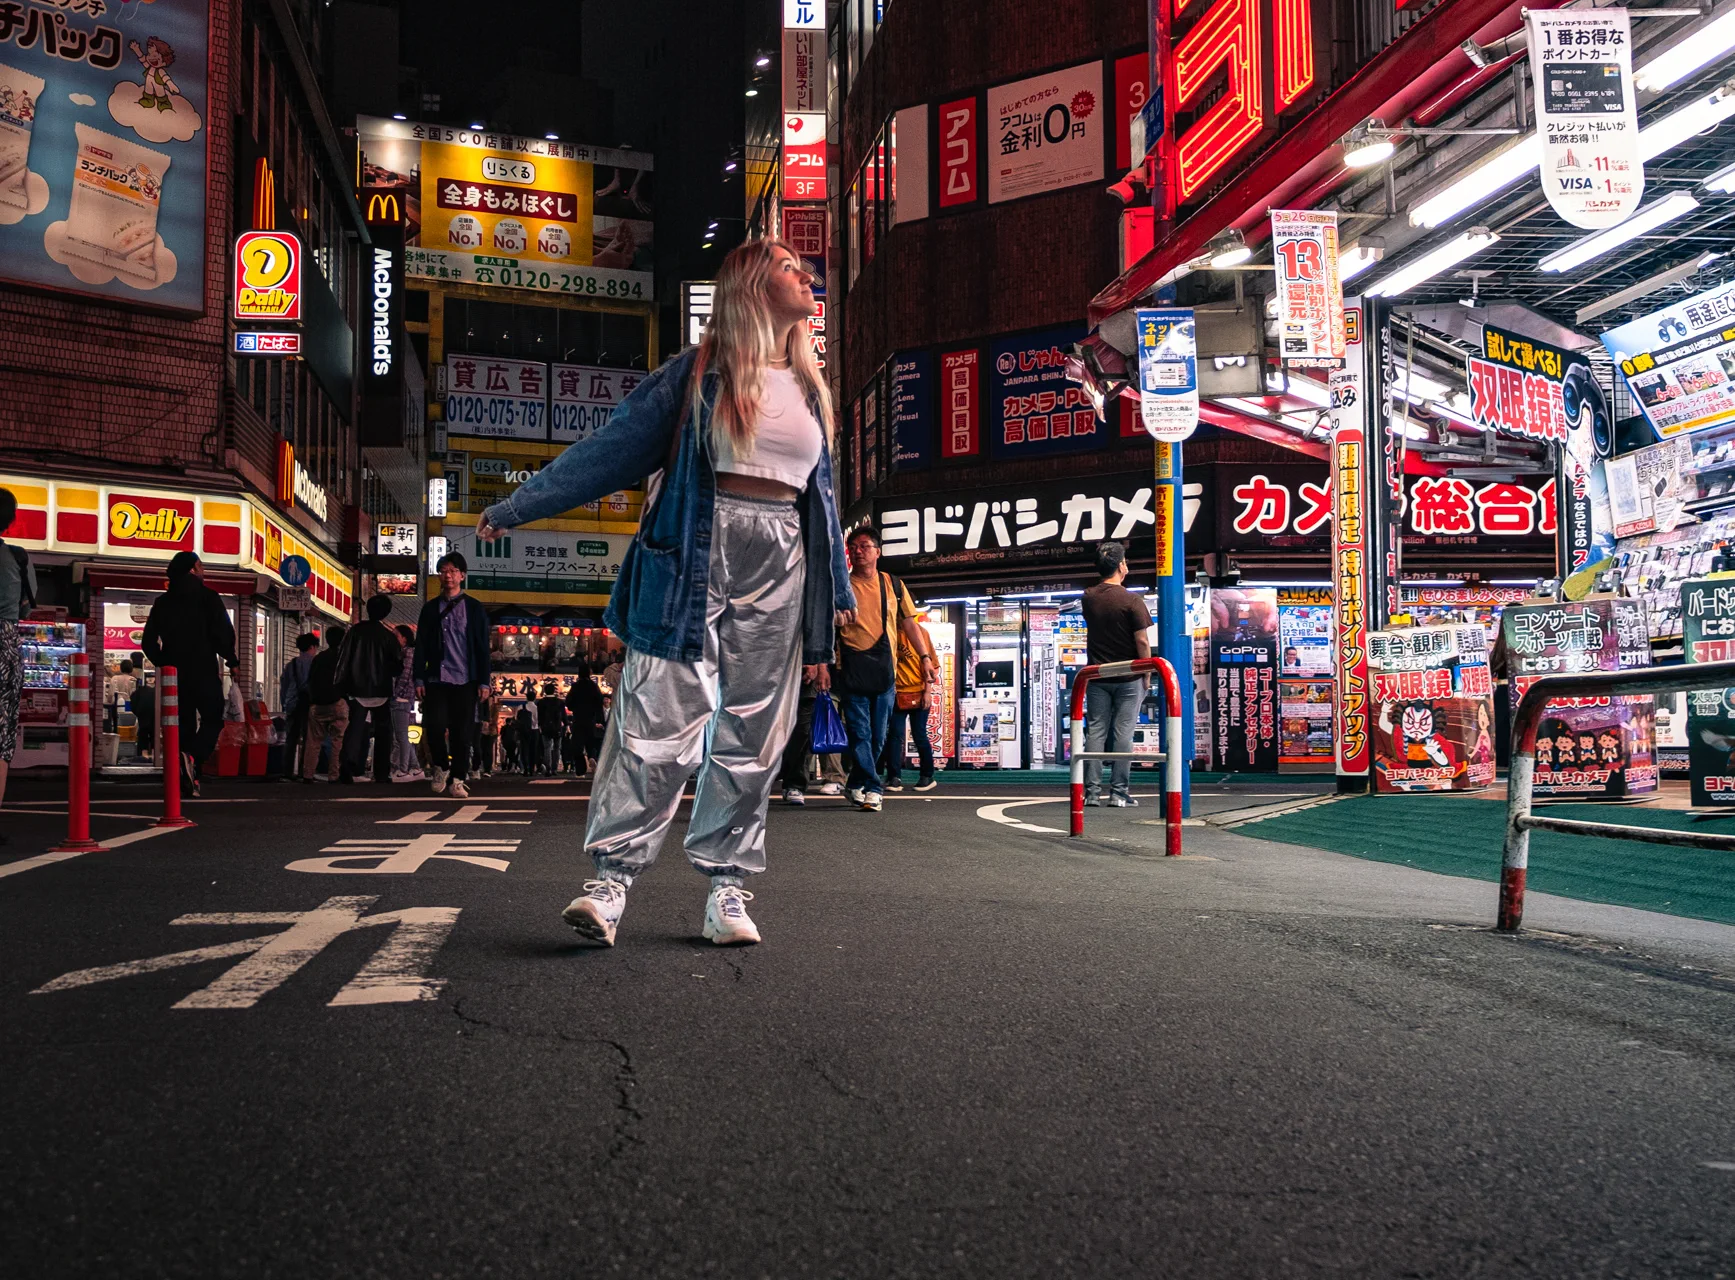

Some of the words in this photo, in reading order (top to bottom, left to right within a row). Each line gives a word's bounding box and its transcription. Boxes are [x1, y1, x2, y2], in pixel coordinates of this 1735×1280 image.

[1543, 28, 1625, 46] 1番お得な
[795, 31, 809, 111] いい部屋ネット
[1000, 85, 1060, 116] はじめての方なら
[1000, 112, 1042, 131] アコムは
[1000, 103, 1086, 156] 金利0円
[1546, 121, 1626, 133] クレジット払いが
[786, 153, 825, 167] アコム
[945, 107, 972, 197] アコム
[80, 159, 128, 184] ランチパック
[487, 163, 531, 180] りらくる
[1594, 157, 1609, 171] 11
[81, 173, 108, 188] たまご
[795, 181, 815, 195] 3F
[1559, 178, 1593, 190] VISA
[1604, 179, 1612, 194] 1
[443, 183, 572, 219] 全身もみほぐし
[458, 223, 473, 231] 全国
[504, 228, 518, 236] 全国
[791, 223, 820, 238] 高価
[448, 230, 483, 247] No.1
[493, 234, 527, 251] No.1
[547, 232, 561, 241] 全国
[537, 239, 571, 256] No.1
[499, 267, 644, 300] 0120-298-894
[239, 287, 298, 316] Daily
[239, 305, 281, 314] YAMAZAKI
[373, 247, 393, 376] McDonald's
[239, 336, 255, 350] 酒
[258, 336, 298, 350] たばこ
[945, 352, 977, 368] カメラ!
[1486, 331, 1562, 380] 試して選べる!
[452, 360, 544, 396] 貸広告
[1003, 374, 1029, 387] JANPARA
[897, 393, 915, 402] Lens
[1469, 360, 1554, 442] 双眼鏡
[953, 367, 970, 454] 高価買取
[1551, 384, 1567, 441] 売場
[1004, 409, 1096, 445] 高価買取
[293, 459, 328, 523] McDonald's
[1337, 442, 1361, 545] 期間限定
[1232, 474, 1557, 535] カメ総合
[109, 501, 194, 542] Daily
[881, 482, 1203, 557] ヨドバシカメラ
[1573, 502, 1589, 548] ならではの
[135, 531, 171, 540] YAMAZAKI
[380, 526, 396, 537] 4F
[524, 545, 569, 559] 完全個室
[936, 551, 974, 564] Yodobashi
[975, 551, 1005, 560] Camera
[525, 560, 598, 574] ワークスペース
[985, 584, 1036, 595] ヨドバシカメラ
[1514, 606, 1601, 634] コンサート
[1370, 631, 1450, 656] 舞台・観劇
[1514, 627, 1604, 654] スポーツ観戦
[1219, 646, 1268, 655] GoPro
[1337, 548, 1368, 761] 特別ポイントアップ
[1379, 655, 1444, 670] におすすめ!
[1521, 652, 1600, 672] におすすめ!
[1374, 670, 1452, 703] 双眼鏡
[1229, 668, 1241, 727] 当館で豊富に
[1243, 667, 1259, 765] 純正アクセサリー
[1385, 767, 1456, 781] ヨドバシカメラ
